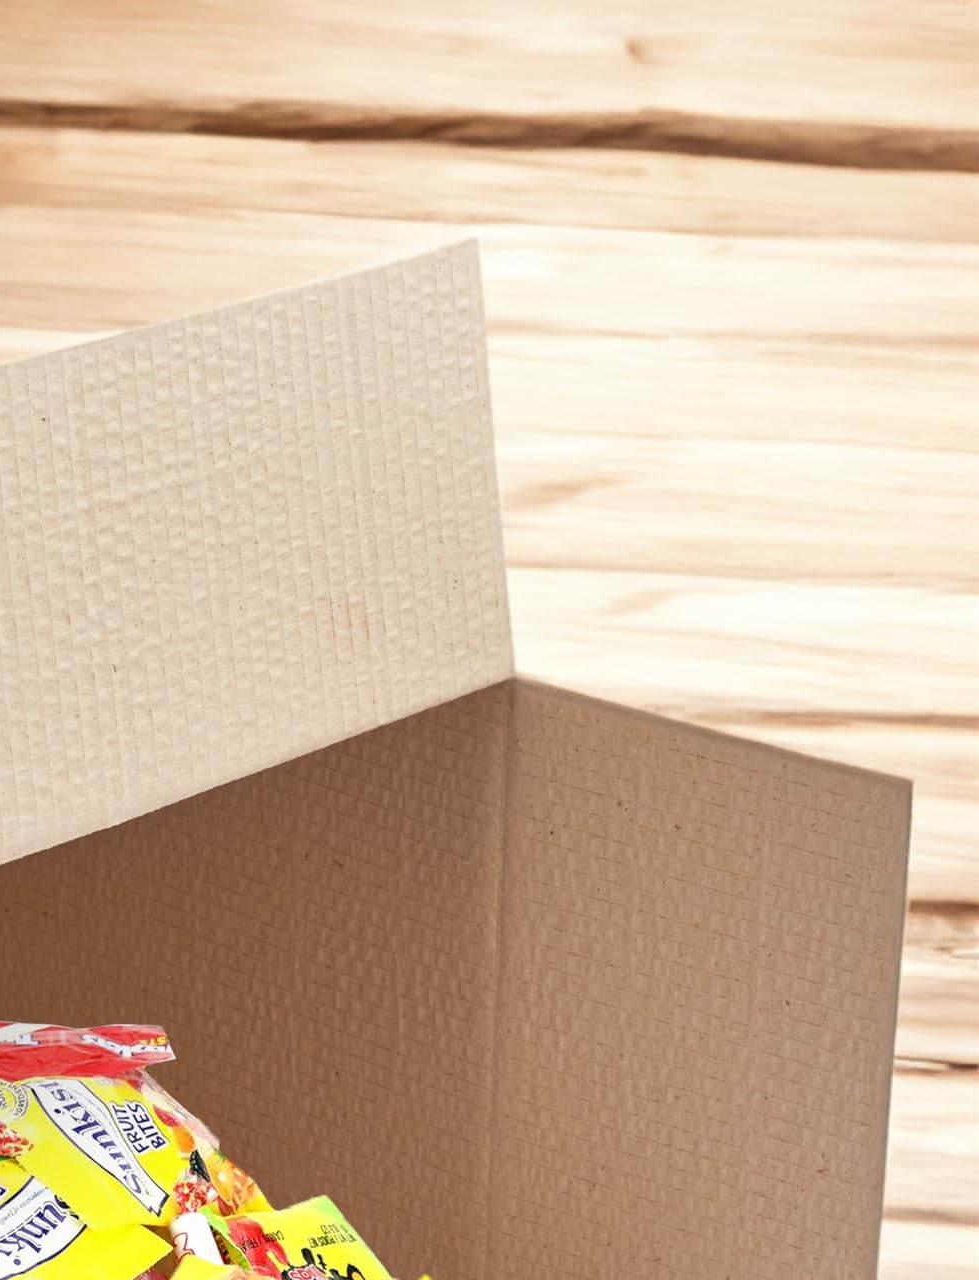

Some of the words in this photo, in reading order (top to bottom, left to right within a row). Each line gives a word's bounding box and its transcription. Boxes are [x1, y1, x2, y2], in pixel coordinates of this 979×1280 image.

[35, 1080, 151, 1198] Sunkist
[113, 1103, 146, 1153] FRUIT
[126, 1103, 167, 1150] BITES
